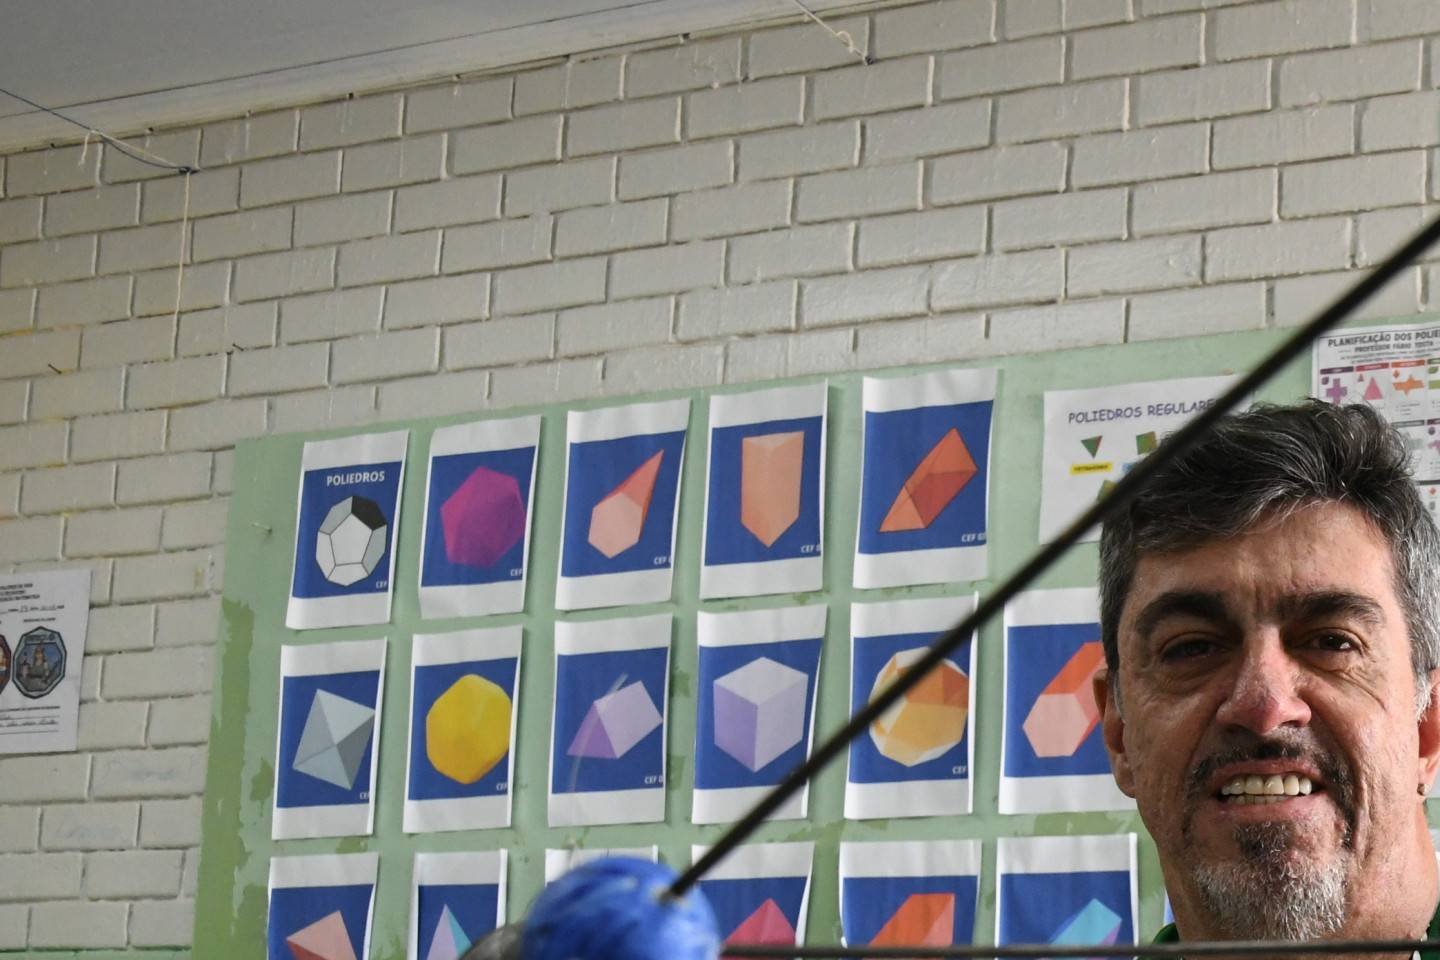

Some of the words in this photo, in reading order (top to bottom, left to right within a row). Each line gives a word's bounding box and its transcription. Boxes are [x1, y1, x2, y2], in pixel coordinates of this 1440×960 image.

[1328, 332, 1391, 347] PLANIFICAÇÃO
[1394, 332, 1412, 342] DOS
[1068, 406, 1142, 424] POLIEDROS
[326, 470, 385, 487] POLIEDROS
[961, 533, 976, 543] CEF
[800, 544, 814, 553] CEF
[653, 556, 667, 565] CEF
[952, 766, 967, 775] CEF
[644, 776, 657, 785] CEF
